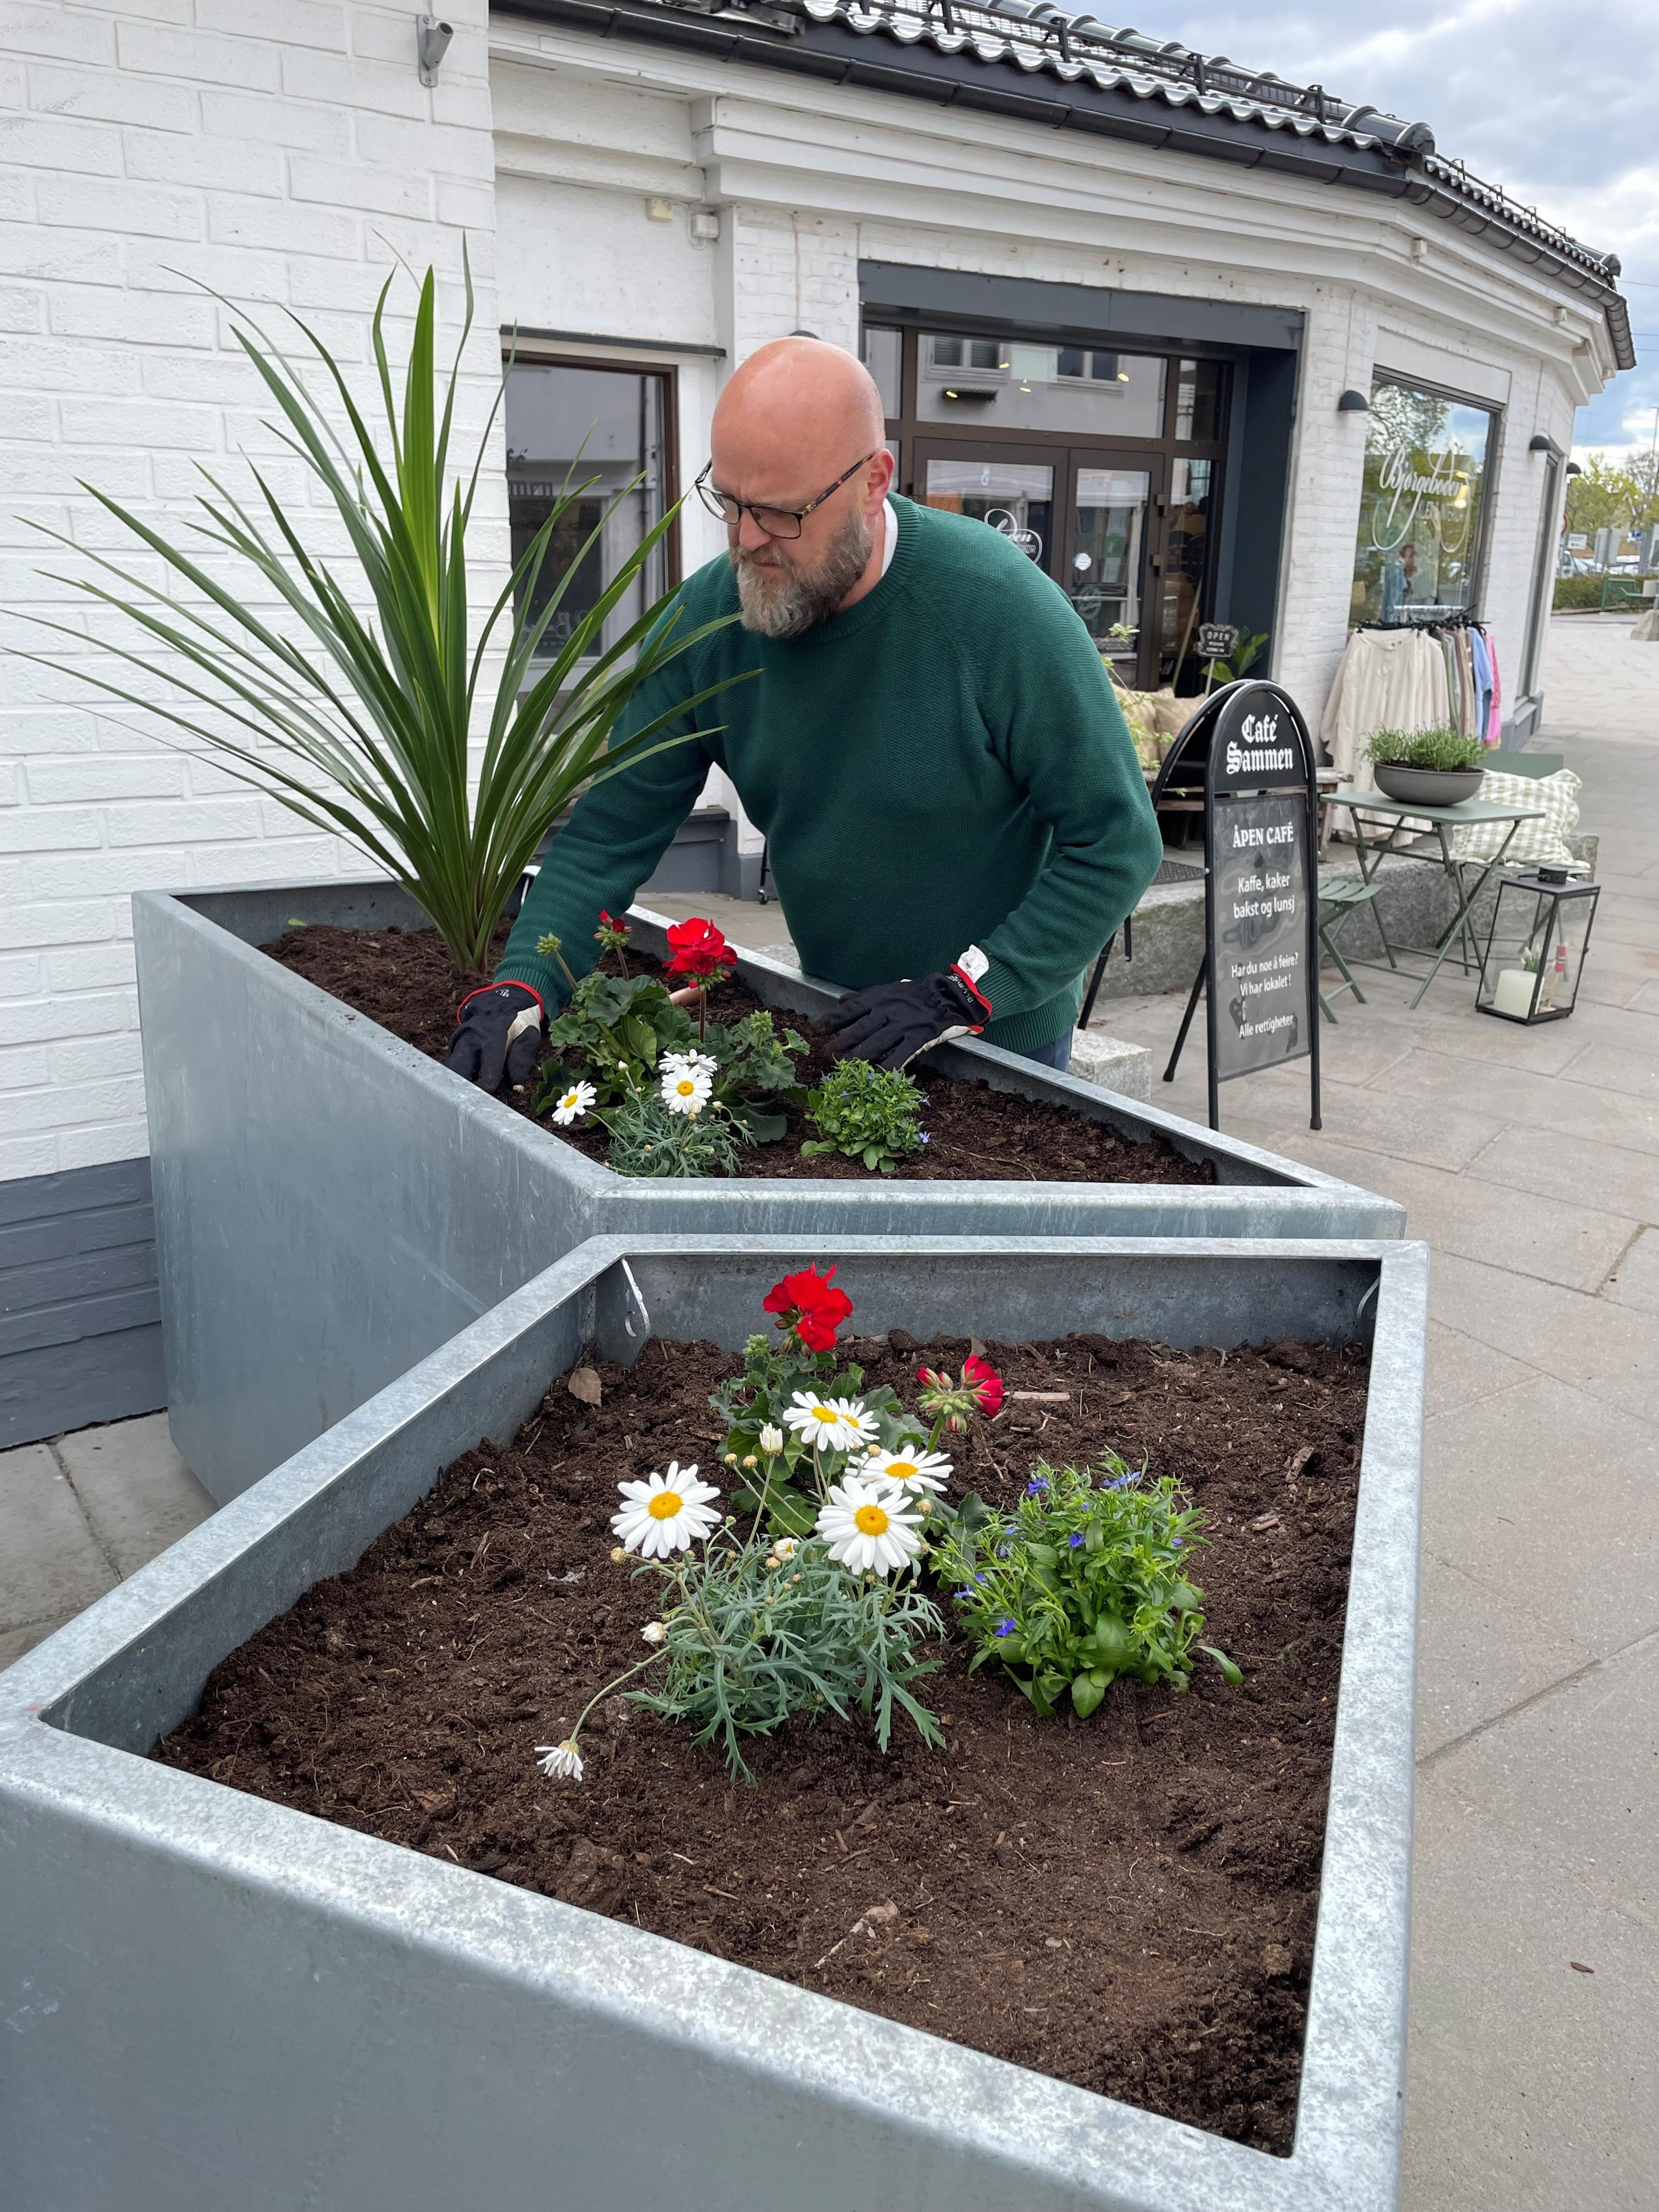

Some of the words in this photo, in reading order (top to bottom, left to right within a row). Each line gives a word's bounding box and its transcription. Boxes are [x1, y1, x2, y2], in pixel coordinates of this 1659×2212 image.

[1207, 631, 1230, 642] OPEN
[1241, 713, 1279, 744] Café
[1226, 740, 1294, 775] Sammen
[1233, 824, 1264, 848] ÅPEN
[1266, 821, 1294, 845] CAFÉ
[1238, 874, 1264, 893] Kaffe,
[1265, 871, 1290, 889] kaker
[1233, 901, 1259, 919] bakst
[1260, 901, 1272, 918] og
[1274, 894, 1295, 914] lunsj
[1231, 964, 1246, 978] Har
[1246, 961, 1257, 975] du
[1259, 960, 1272, 973] noe
[1273, 955, 1278, 970] å
[1279, 952, 1298, 968] feire?
[1240, 982, 1248, 997] Vi
[1249, 981, 1263, 995] har
[1239, 1022, 1254, 1038] Alle
[1255, 1015, 1294, 1034] rettigheter
